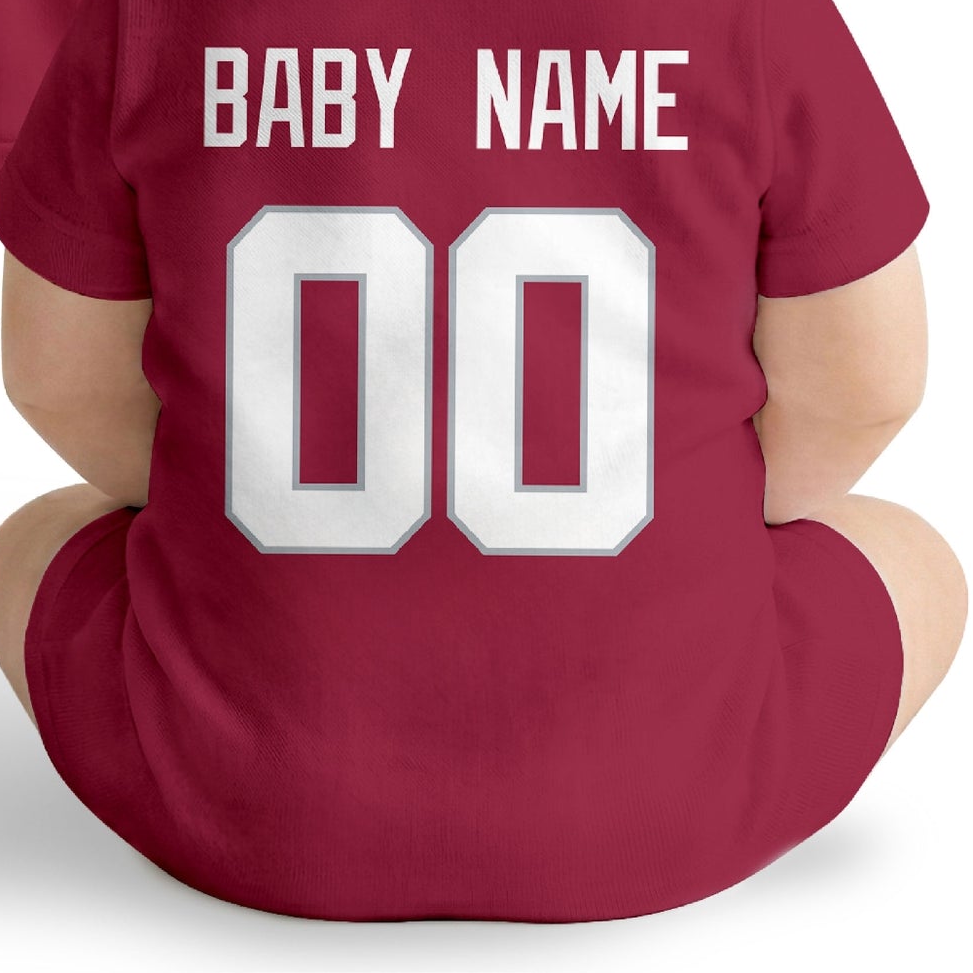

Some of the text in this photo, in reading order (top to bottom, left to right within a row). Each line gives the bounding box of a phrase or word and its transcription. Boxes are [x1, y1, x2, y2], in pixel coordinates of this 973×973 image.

[203, 46, 690, 151] BABY NAME
[225, 204, 657, 557] 00
